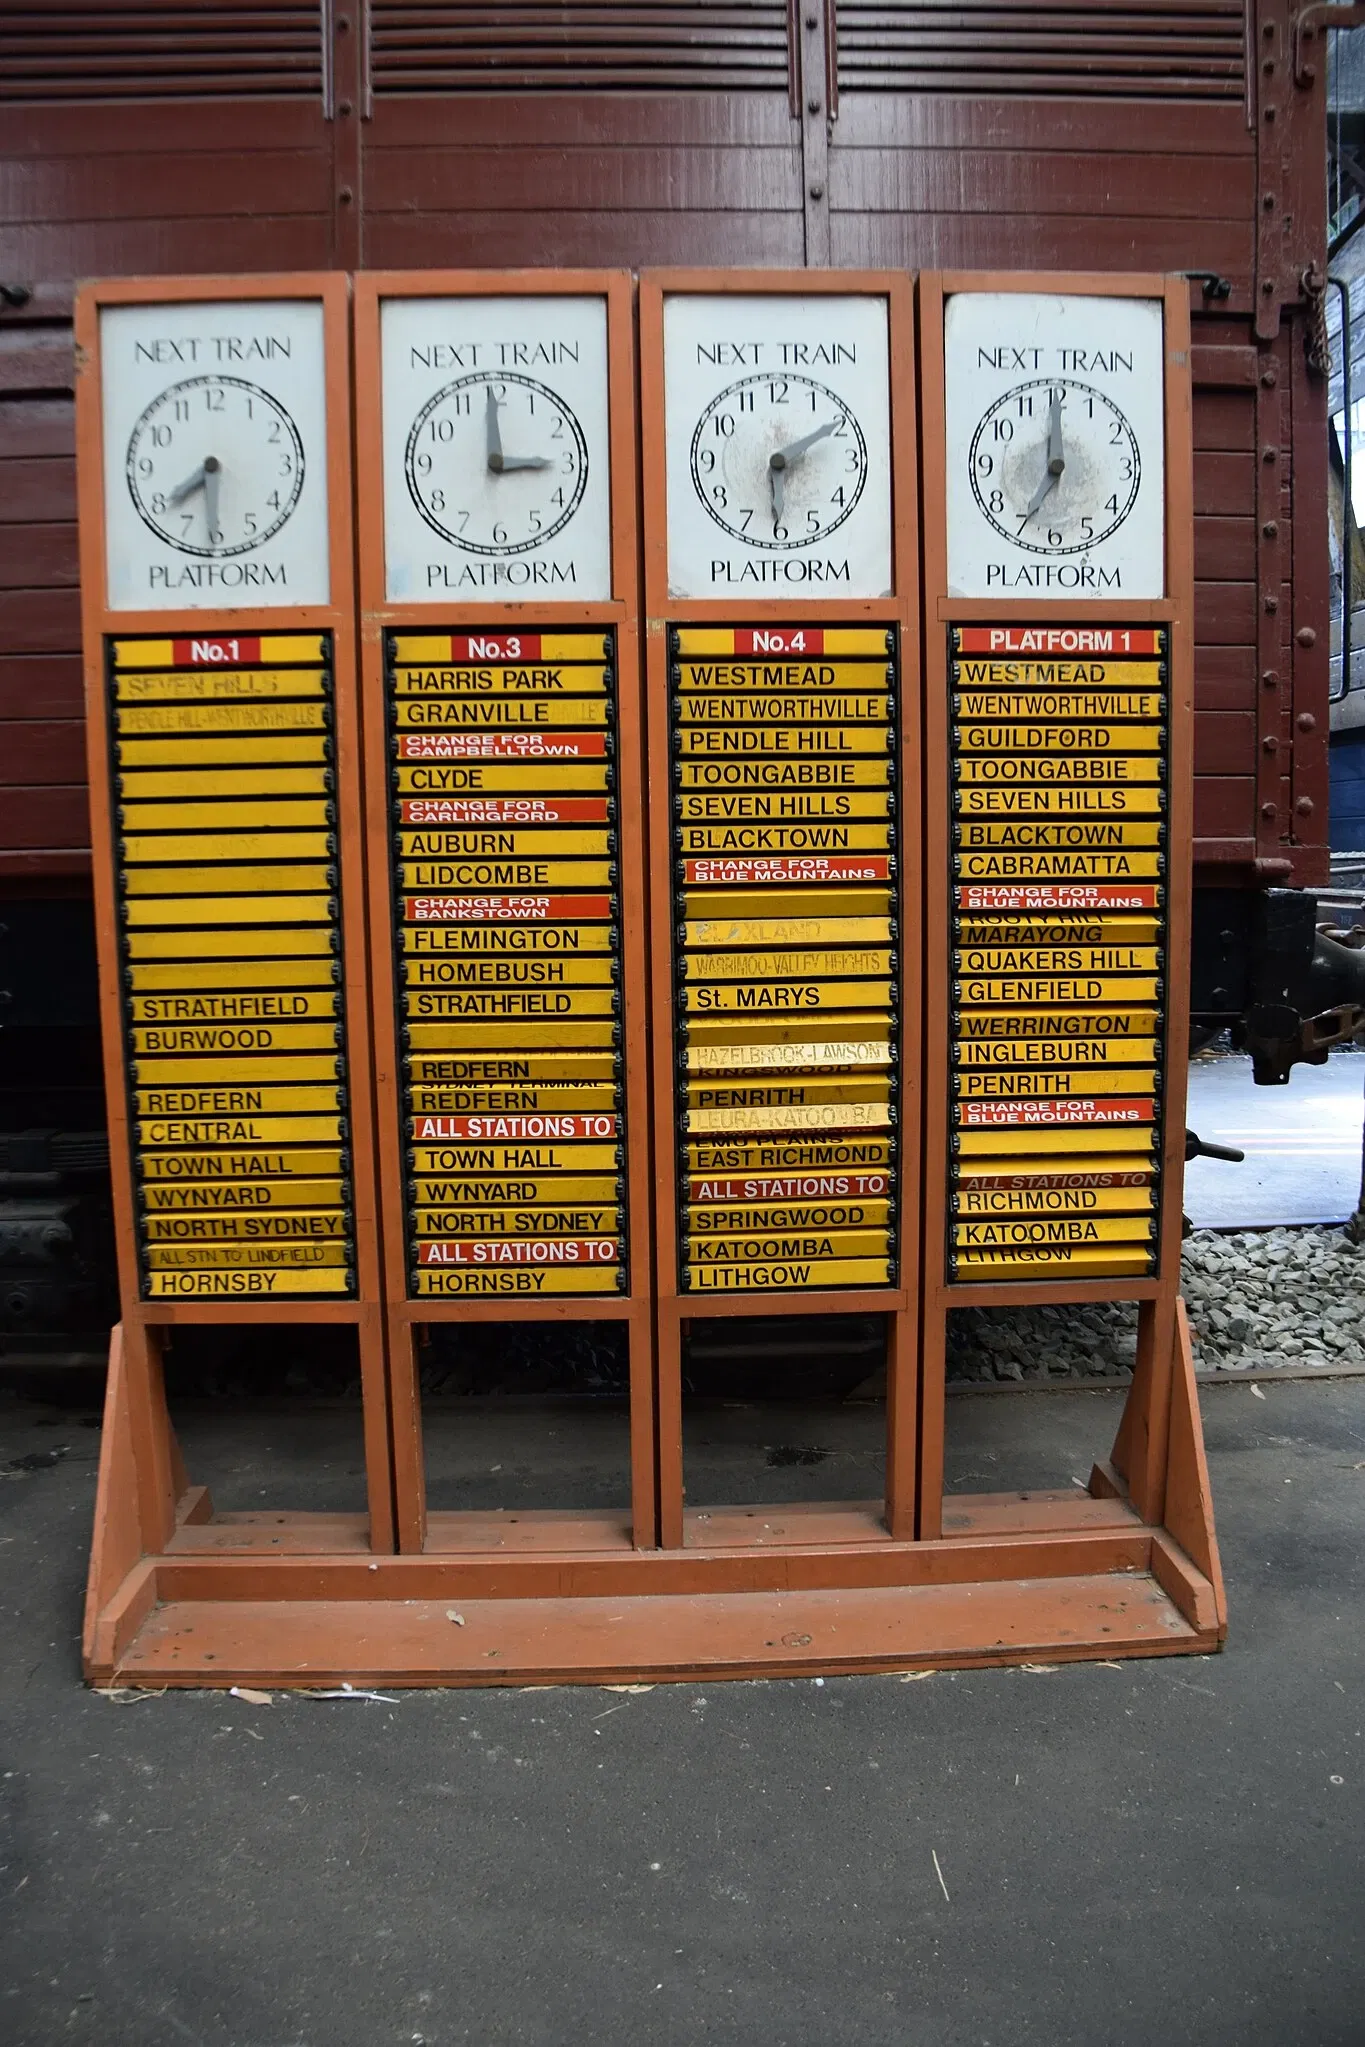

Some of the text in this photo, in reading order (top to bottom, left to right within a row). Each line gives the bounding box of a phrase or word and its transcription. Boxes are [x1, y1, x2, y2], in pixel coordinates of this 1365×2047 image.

[135, 336, 292, 363] NEXT TRAIN
[411, 342, 580, 369] NEXT TRAIN
[697, 343, 857, 366] NEXT TRAIN
[978, 347, 1133, 373] NEXT TRAIN
[734, 391, 754, 412] 11
[764, 382, 789, 404] 12
[806, 391, 816, 412] 1
[454, 394, 470, 415] 11
[528, 394, 534, 415] 1
[1014, 396, 1033, 417] 11
[1083, 398, 1093, 418] 1
[430, 419, 454, 442] 10
[551, 416, 564, 438] 2
[710, 414, 735, 437] 10
[833, 415, 848, 437] 2
[990, 419, 1014, 441] 10
[1109, 422, 1123, 445] 2
[418, 454, 432, 476] 9
[562, 452, 575, 474] 3
[701, 450, 715, 473] 9
[845, 450, 859, 472] 3
[978, 455, 993, 478] 9
[1119, 457, 1133, 480] 3
[431, 490, 445, 512] 8
[551, 487, 565, 508] 4
[713, 486, 728, 508] 8
[831, 486, 846, 507] 4
[990, 490, 1004, 513] 8
[1104, 494, 1119, 515] 4
[458, 511, 470, 533] 7
[528, 510, 541, 533] 5
[740, 509, 754, 531] 7
[773, 518, 788, 540] 6
[806, 511, 820, 533] 5
[1016, 514, 1029, 536] 7
[1080, 518, 1093, 539] 5
[493, 522, 508, 543] 6
[1048, 529, 1062, 546] 6
[149, 564, 288, 589] PLATFORM
[426, 561, 578, 587] PLATFORM
[711, 559, 851, 584] PLATFORM
[986, 564, 1122, 589] PLATFORM
[468, 637, 521, 659] No.3
[753, 631, 806, 652] No.4
[991, 631, 1130, 650] PLATFORM 1
[191, 640, 239, 662] No.1
[407, 670, 563, 690] HARRIS PARK
[690, 667, 835, 685] WESTMEAD
[965, 664, 1105, 683] WESTMEAD
[407, 703, 549, 722] GRANVILLE
[688, 699, 879, 718] WENTWORTHVILLE
[966, 696, 1151, 714] WENTWORTHVILLE
[406, 735, 543, 746] CHANGE FOR
[690, 731, 852, 750] PENDLE HILL
[968, 728, 1110, 747] GUILDFORD
[406, 745, 578, 756] CAMPBELLTOWN
[410, 769, 482, 789] CLYDE
[688, 764, 855, 784] TOONGABBIE
[967, 760, 1128, 779] TOONGABBIE
[409, 801, 545, 811] CHANGE FOR
[688, 796, 851, 816] SEVEN HILLS
[969, 791, 1126, 810] SEVEN HILLS
[409, 811, 559, 821] CARLINGFORD
[410, 834, 515, 853] AUBURN
[690, 828, 848, 848] BLACKTOWN
[970, 826, 1123, 845] BLACKTOWN
[416, 865, 549, 884] LIDCOMBE
[694, 859, 829, 870] CHANGE FOR
[968, 856, 1131, 875] CABRAMATTA
[695, 869, 876, 881] BLUE MOUNTAINS
[968, 888, 1098, 897] CHANGE FOR
[414, 898, 550, 908] CHANGE FOR
[968, 898, 1143, 908] BLUE MOUNTAINS
[415, 908, 546, 919] BANKSTOWN
[415, 930, 579, 949] FLEMINGTON
[967, 926, 1103, 942] MARAYONG
[968, 951, 1142, 970] QUAKERS HILL
[419, 963, 564, 982] HOMEBUSH
[697, 987, 820, 1008] St. MARYS
[968, 981, 1102, 1001] GLENFIELD
[144, 996, 309, 1018] STRATHFIELD
[418, 994, 571, 1014] STRATHFIELD
[967, 1016, 1130, 1035] WERRINGTON
[146, 1030, 272, 1050] BURWOOD
[968, 1042, 1107, 1062] INGLEBURN
[422, 1061, 530, 1078] REDFERN
[968, 1074, 1071, 1094] PENRITH
[148, 1091, 262, 1112] REDFERN
[421, 1092, 538, 1110] REDFERN
[700, 1089, 805, 1106] PENRITH
[967, 1102, 1095, 1112] CHANGE FOR
[423, 1117, 610, 1137] ALL STATIONS TO
[968, 1111, 1139, 1123] BLUE MOUNTAINS
[150, 1123, 262, 1142] CENTRAL
[151, 1156, 292, 1175] TOWN HALL
[425, 1150, 562, 1169] TOWN HALL
[697, 1146, 883, 1167] EAST RICHMOND
[698, 1176, 884, 1199] ALL STATIONS TO
[967, 1173, 1146, 1190] ALL STATIONS TO
[153, 1187, 271, 1206] WYNYARD
[426, 1183, 537, 1201] WYNYARD
[967, 1190, 1097, 1211] RICHMOND
[156, 1217, 337, 1237] NORTH SYDNEY
[427, 1213, 604, 1231] NORTH SYDNEY
[697, 1208, 864, 1229] SPRINGWOOD
[966, 1222, 1099, 1243] KATOOMBA
[159, 1248, 324, 1264] ALL STN TO LINDFIELD
[428, 1241, 614, 1262] ALL STATIONS TO
[698, 1239, 833, 1260] KATOOMBA
[161, 1273, 277, 1292] HORNSBY
[428, 1273, 546, 1292] HORNSBY
[699, 1266, 810, 1287] LITHGOW
